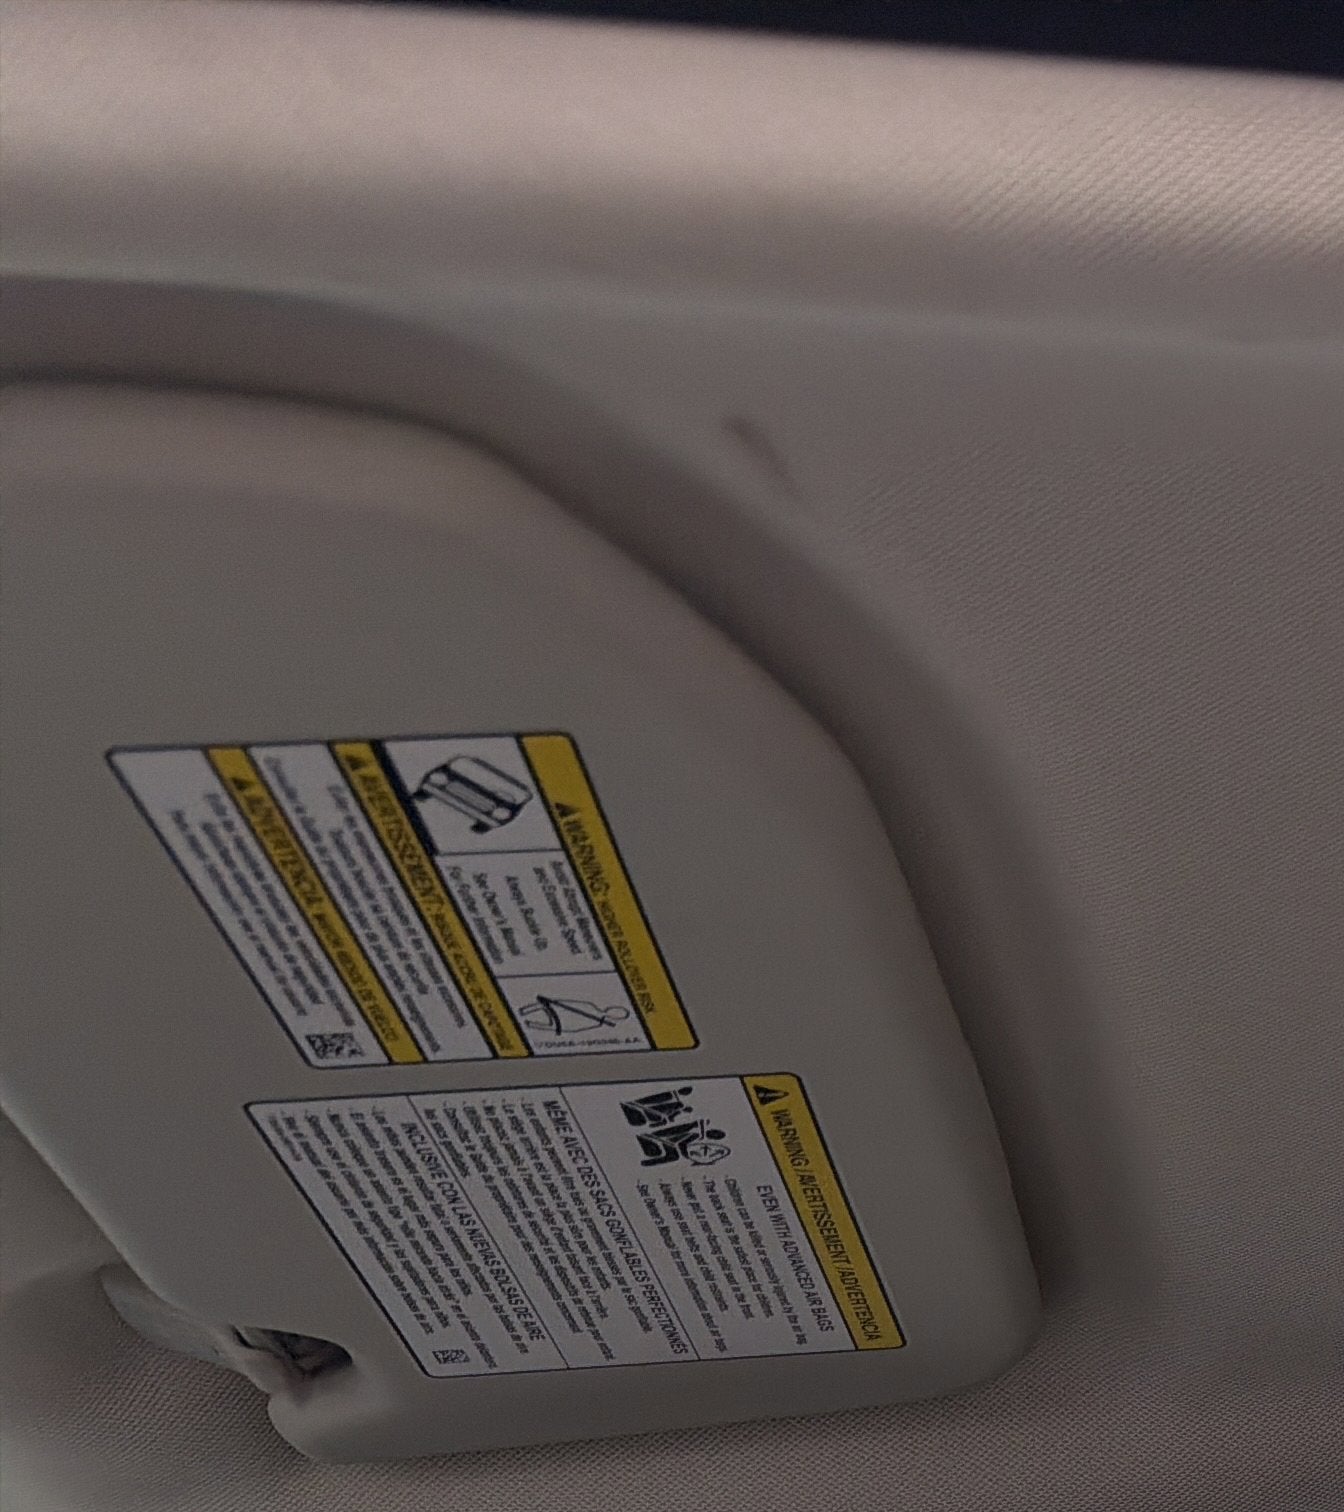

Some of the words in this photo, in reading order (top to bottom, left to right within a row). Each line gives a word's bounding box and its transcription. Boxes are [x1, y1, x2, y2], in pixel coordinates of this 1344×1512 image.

[561, 819, 612, 895] WARNING:
[540, 1100, 575, 1133] MÊME
[397, 1122, 450, 1179] INCLUSIVE
[558, 1134, 591, 1164] AVEC
[767, 1109, 811, 1166] WARNING
[574, 1165, 603, 1187] DES
[433, 1180, 465, 1204] CON
[586, 1189, 618, 1217] SACS
[754, 1184, 783, 1212] EVEN
[448, 1205, 478, 1226] LAS
[767, 1213, 795, 1238] WITH
[462, 1227, 502, 1266] NUEVAS
[602, 1218, 652, 1282] GONFLABLES
[779, 1240, 817, 1289] ADVANCED
[486, 1267, 526, 1305] BOLSAS
[801, 1290, 824, 1306] AIR
[518, 1320, 547, 1340] AIRE
[637, 1283, 689, 1353] PERFECTIONNÉS
[809, 1307, 835, 1331] BAGS
